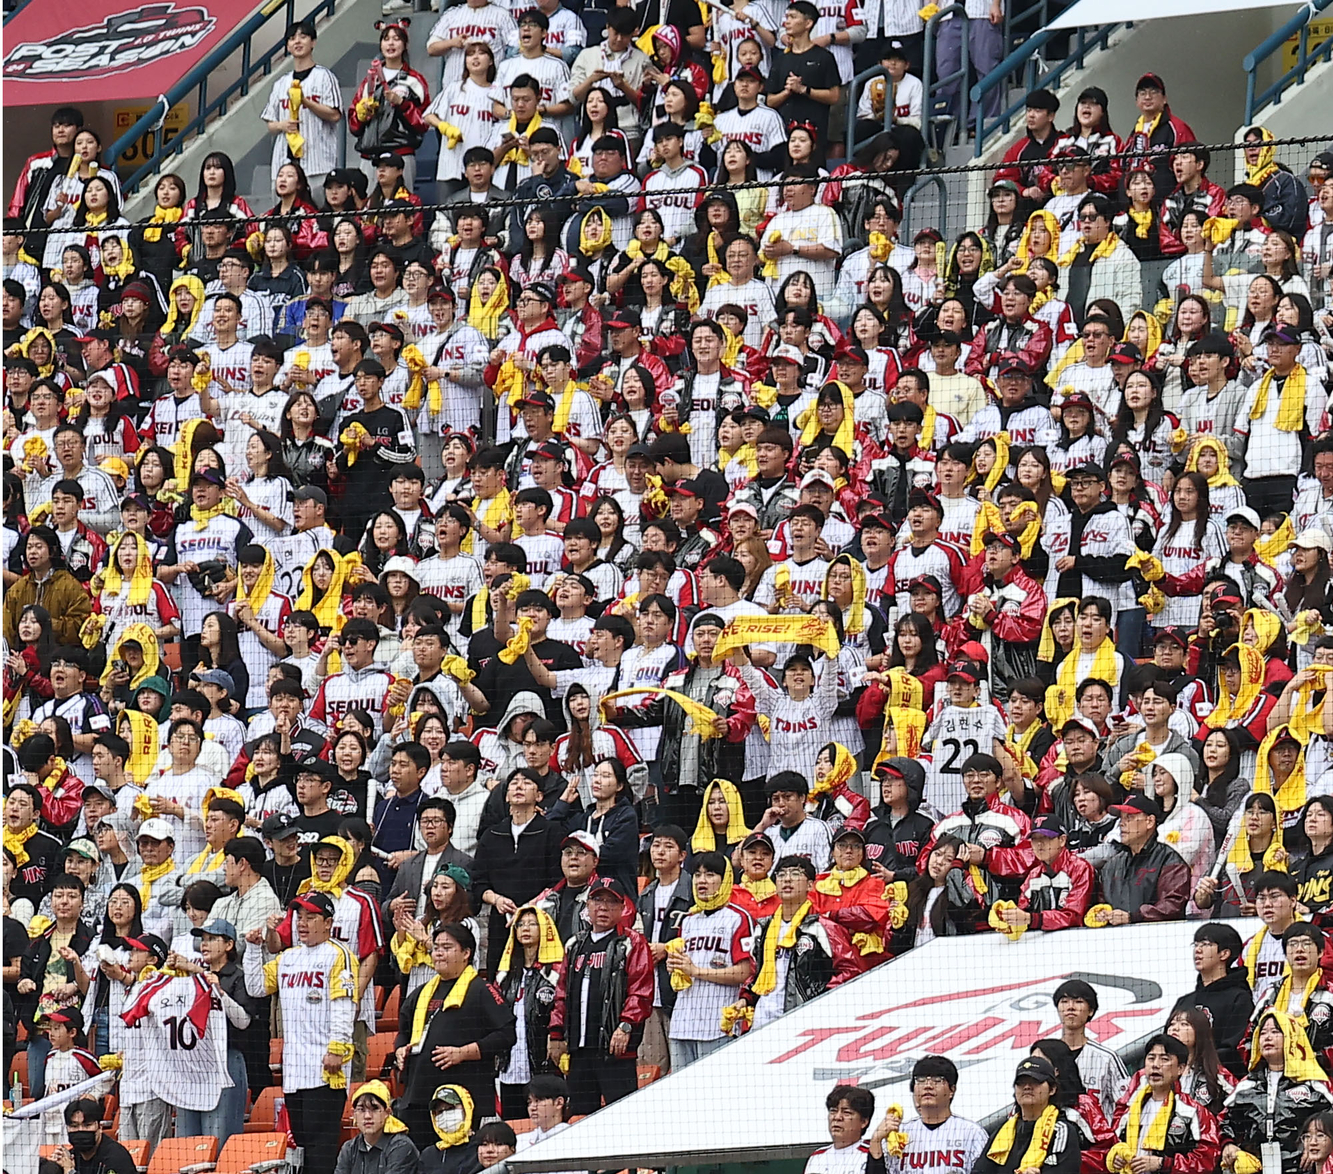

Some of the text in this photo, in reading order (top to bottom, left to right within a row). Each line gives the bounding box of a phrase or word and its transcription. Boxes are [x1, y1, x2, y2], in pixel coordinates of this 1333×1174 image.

[16, 36, 134, 60] POST
[27, 31, 205, 74] SEASON
[683, 934, 730, 955] SEOUL
[280, 970, 326, 989] TWINS
[162, 1015, 197, 1051] 10
[1083, 1075, 1098, 1086] LG
[899, 1150, 965, 1171] TWINS
